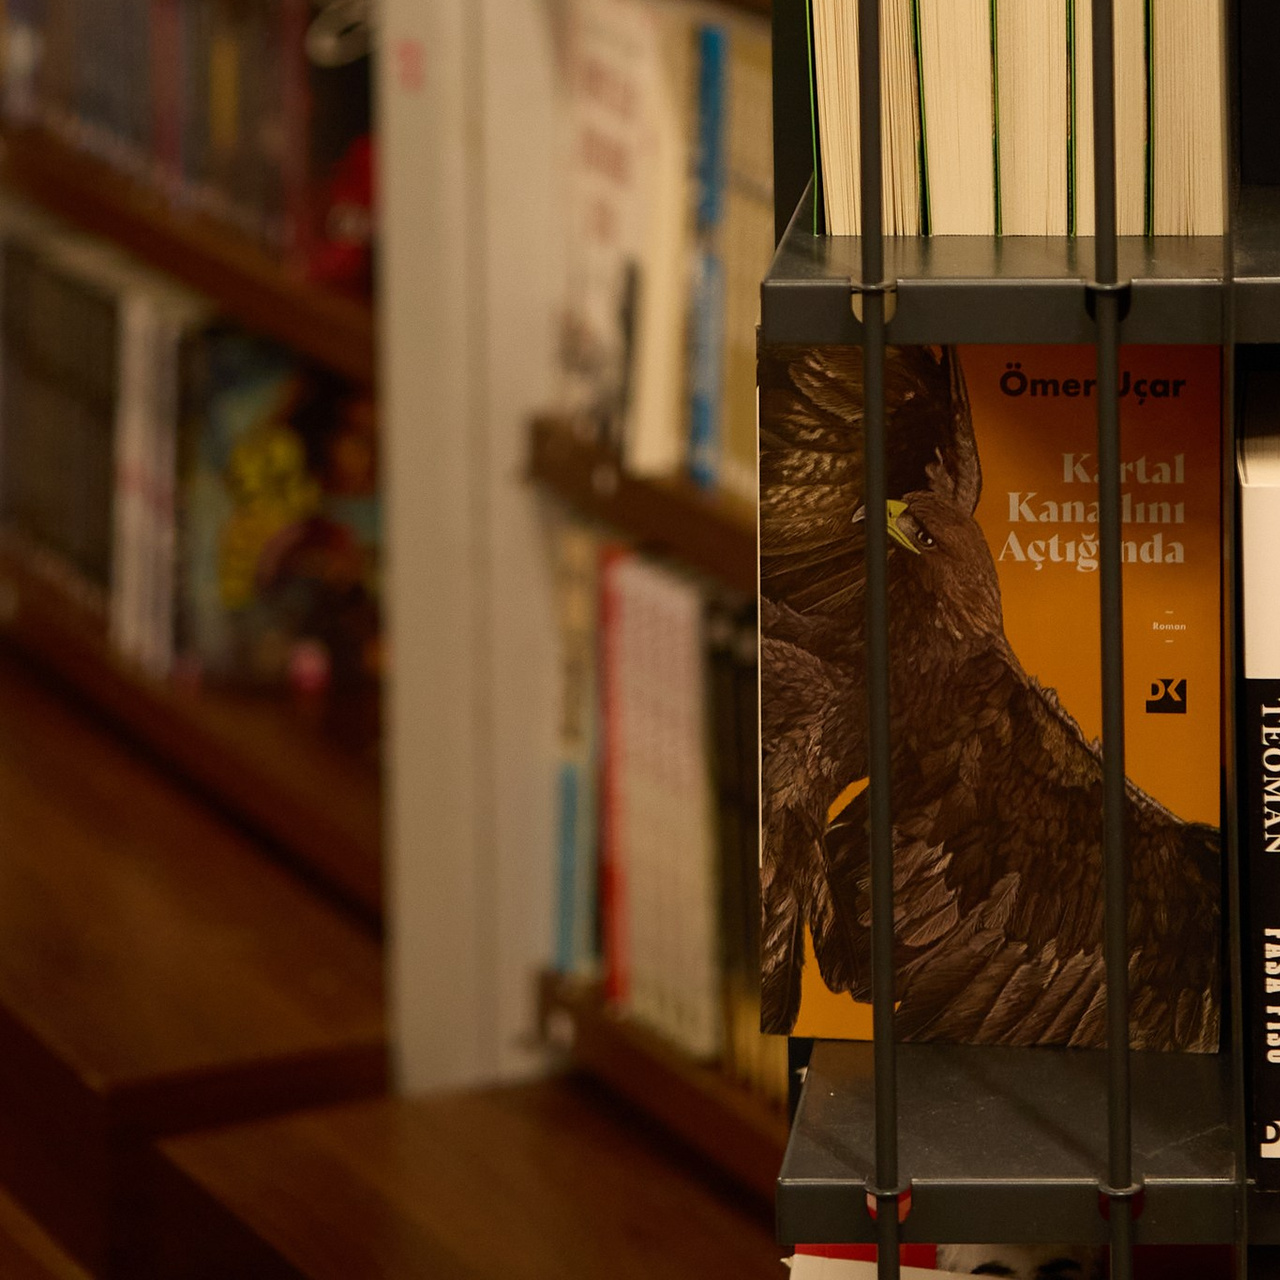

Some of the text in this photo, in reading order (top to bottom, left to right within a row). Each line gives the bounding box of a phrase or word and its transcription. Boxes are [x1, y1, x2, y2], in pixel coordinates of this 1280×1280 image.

[1000, 362, 1098, 398] Ömer
[1061, 452, 1186, 485] Krtal
[997, 530, 1186, 573] Açtığnda
[1152, 621, 1187, 631] Roman
